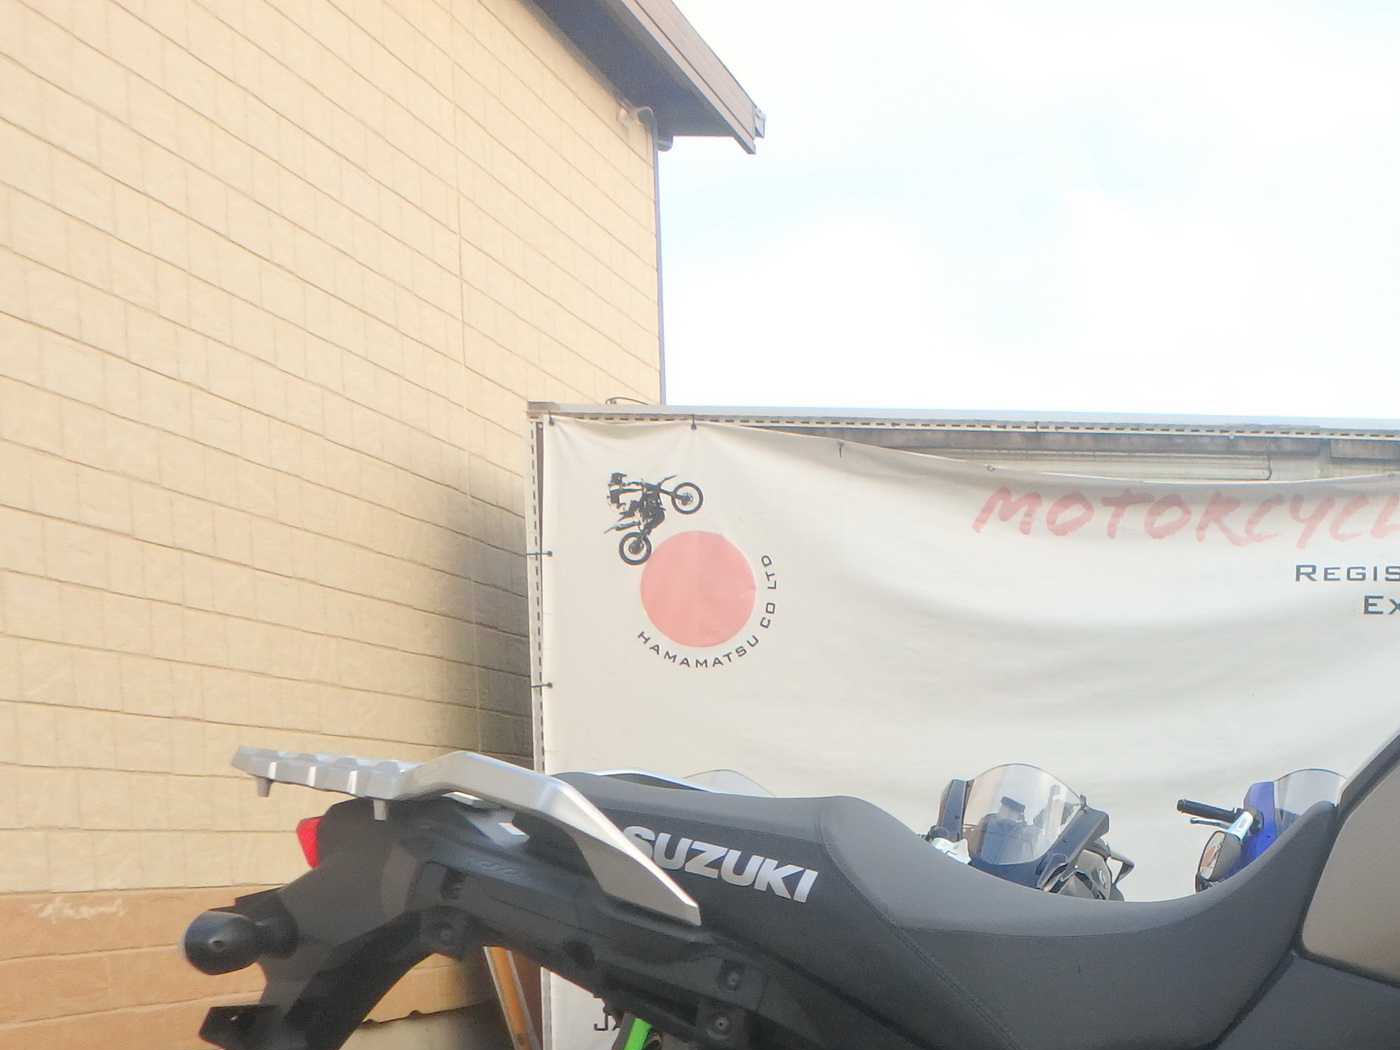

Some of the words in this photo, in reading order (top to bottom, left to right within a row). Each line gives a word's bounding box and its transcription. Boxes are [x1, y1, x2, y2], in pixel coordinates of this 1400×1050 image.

[761, 555, 777, 590] LTD
[760, 602, 776, 629] CO
[637, 631, 760, 668] HAMAMATSU
[622, 825, 819, 903] SUZUKI
